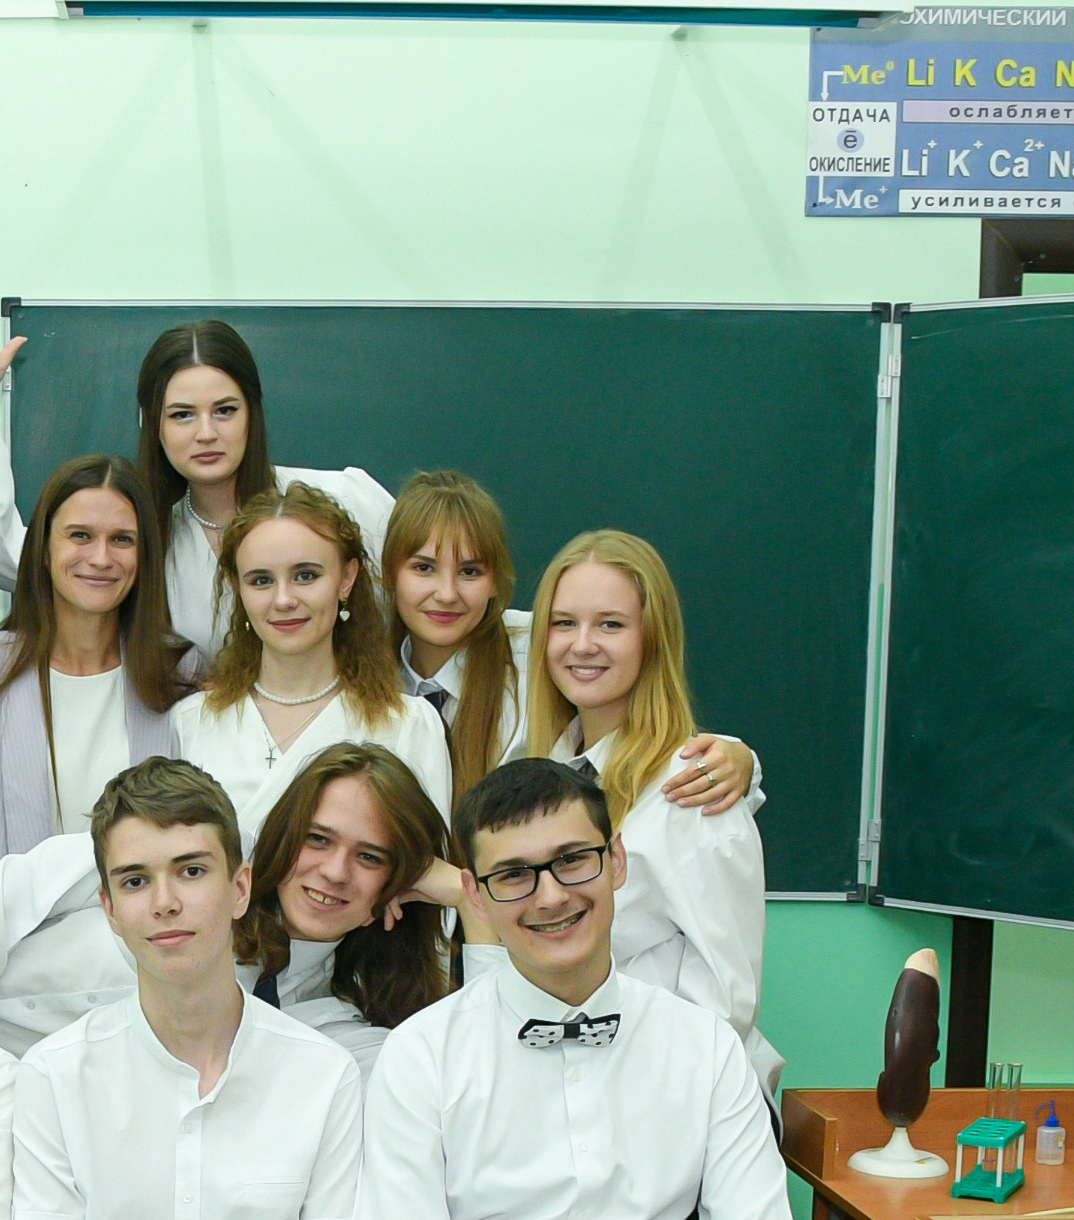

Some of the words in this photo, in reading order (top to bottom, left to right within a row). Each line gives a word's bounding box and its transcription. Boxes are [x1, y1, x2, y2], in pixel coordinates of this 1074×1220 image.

[907, 58, 935, 86] Li
[954, 58, 978, 87] K
[995, 58, 1036, 87] Ca
[812, 107, 891, 124] ОТДАЧА
[809, 156, 891, 173] ОКИСЛЕНИЕ
[911, 195, 1062, 210] усиливается
